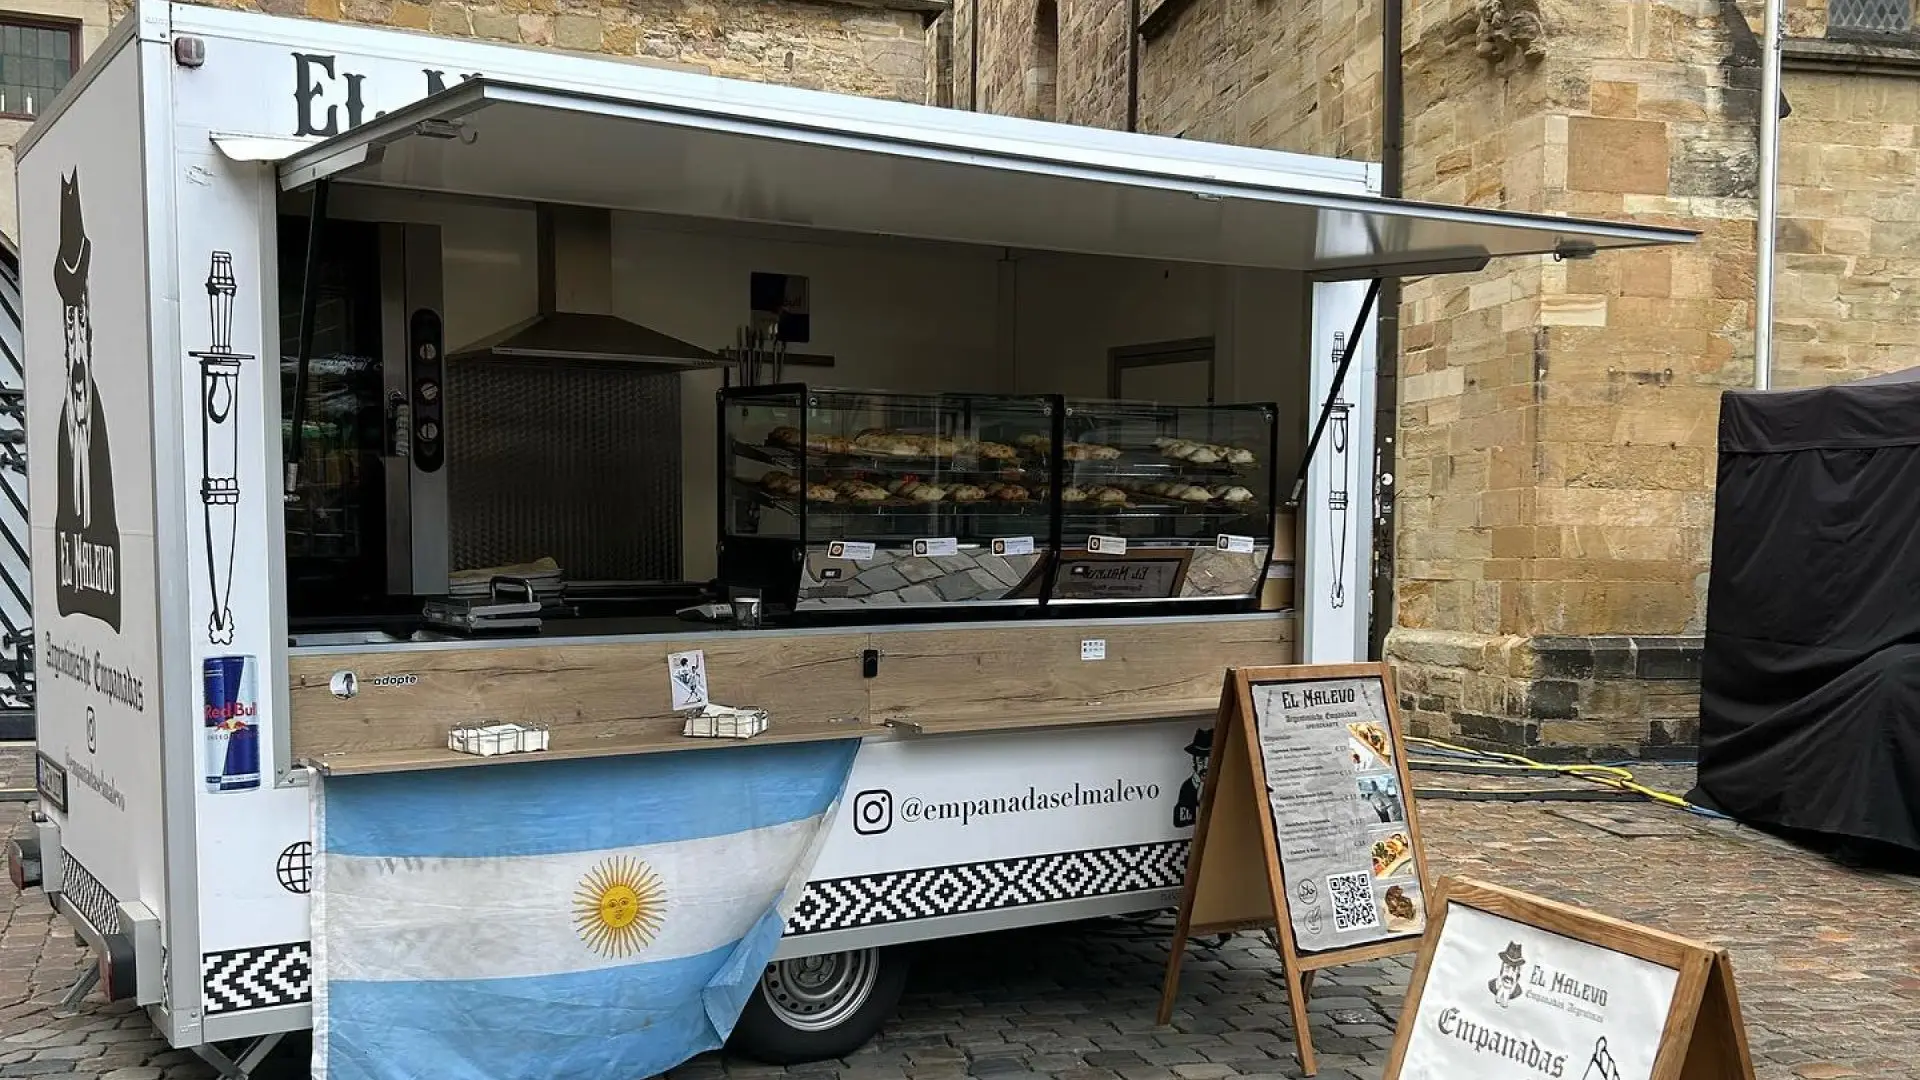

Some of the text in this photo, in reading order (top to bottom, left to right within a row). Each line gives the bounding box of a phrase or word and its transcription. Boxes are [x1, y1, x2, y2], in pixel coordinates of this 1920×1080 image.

[60, 531, 114, 595] EL MALEVO
[94, 648, 144, 713] Empanadas
[374, 676, 417, 687] adopte
[1282, 688, 1355, 709] EL MALEVO
[205, 702, 232, 719] Red
[900, 778, 1160, 826] @empanadaselmalevo
[1530, 965, 1608, 1007] EL MALEVO
[1437, 1006, 1568, 1079] Empanadas
